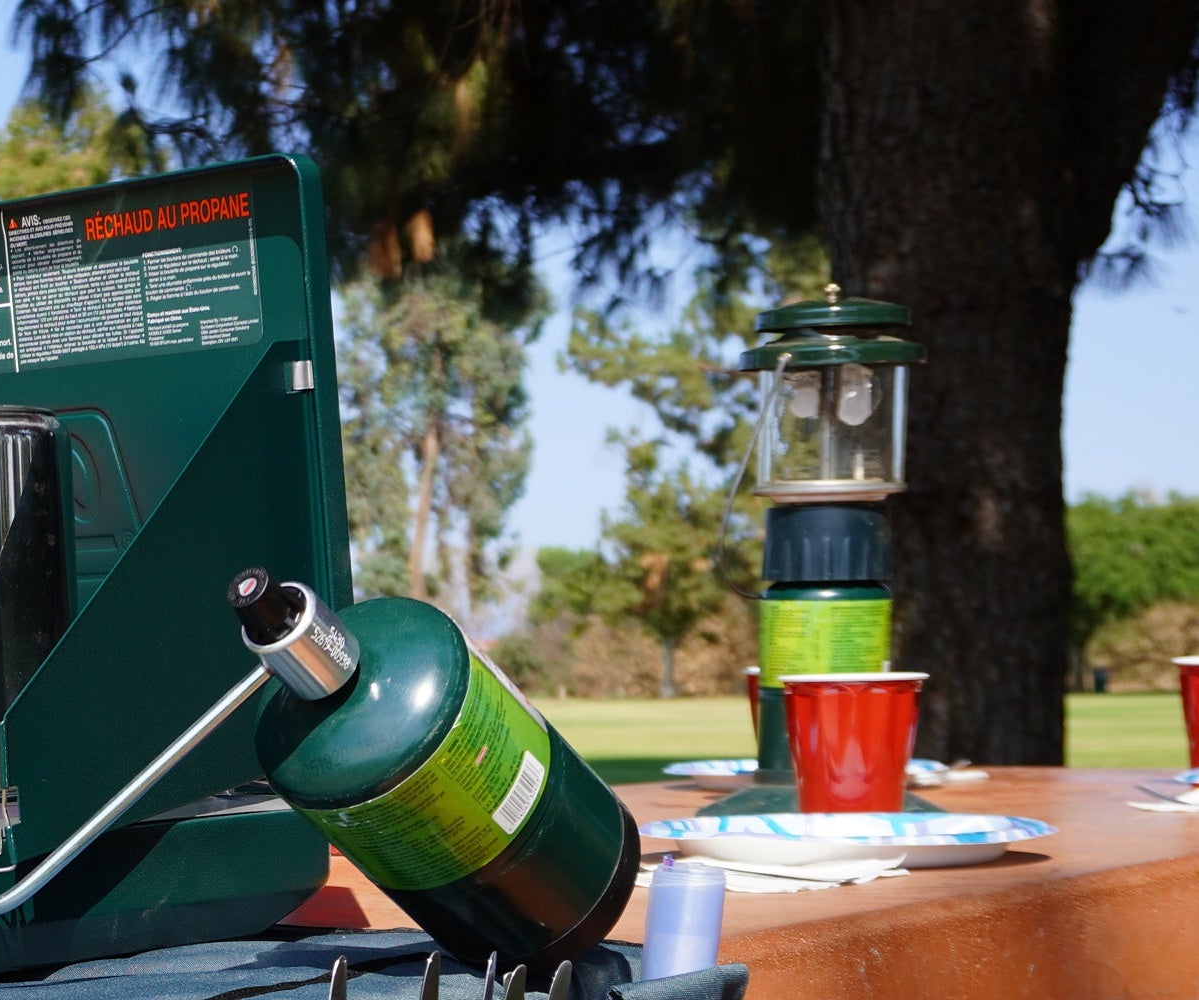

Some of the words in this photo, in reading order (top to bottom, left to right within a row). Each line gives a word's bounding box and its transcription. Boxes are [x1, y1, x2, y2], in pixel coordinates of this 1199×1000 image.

[22, 215, 41, 227] AVIS:
[85, 208, 153, 241] RÉCHAUD
[157, 205, 176, 230] AU
[180, 192, 250, 226] PROPANE
